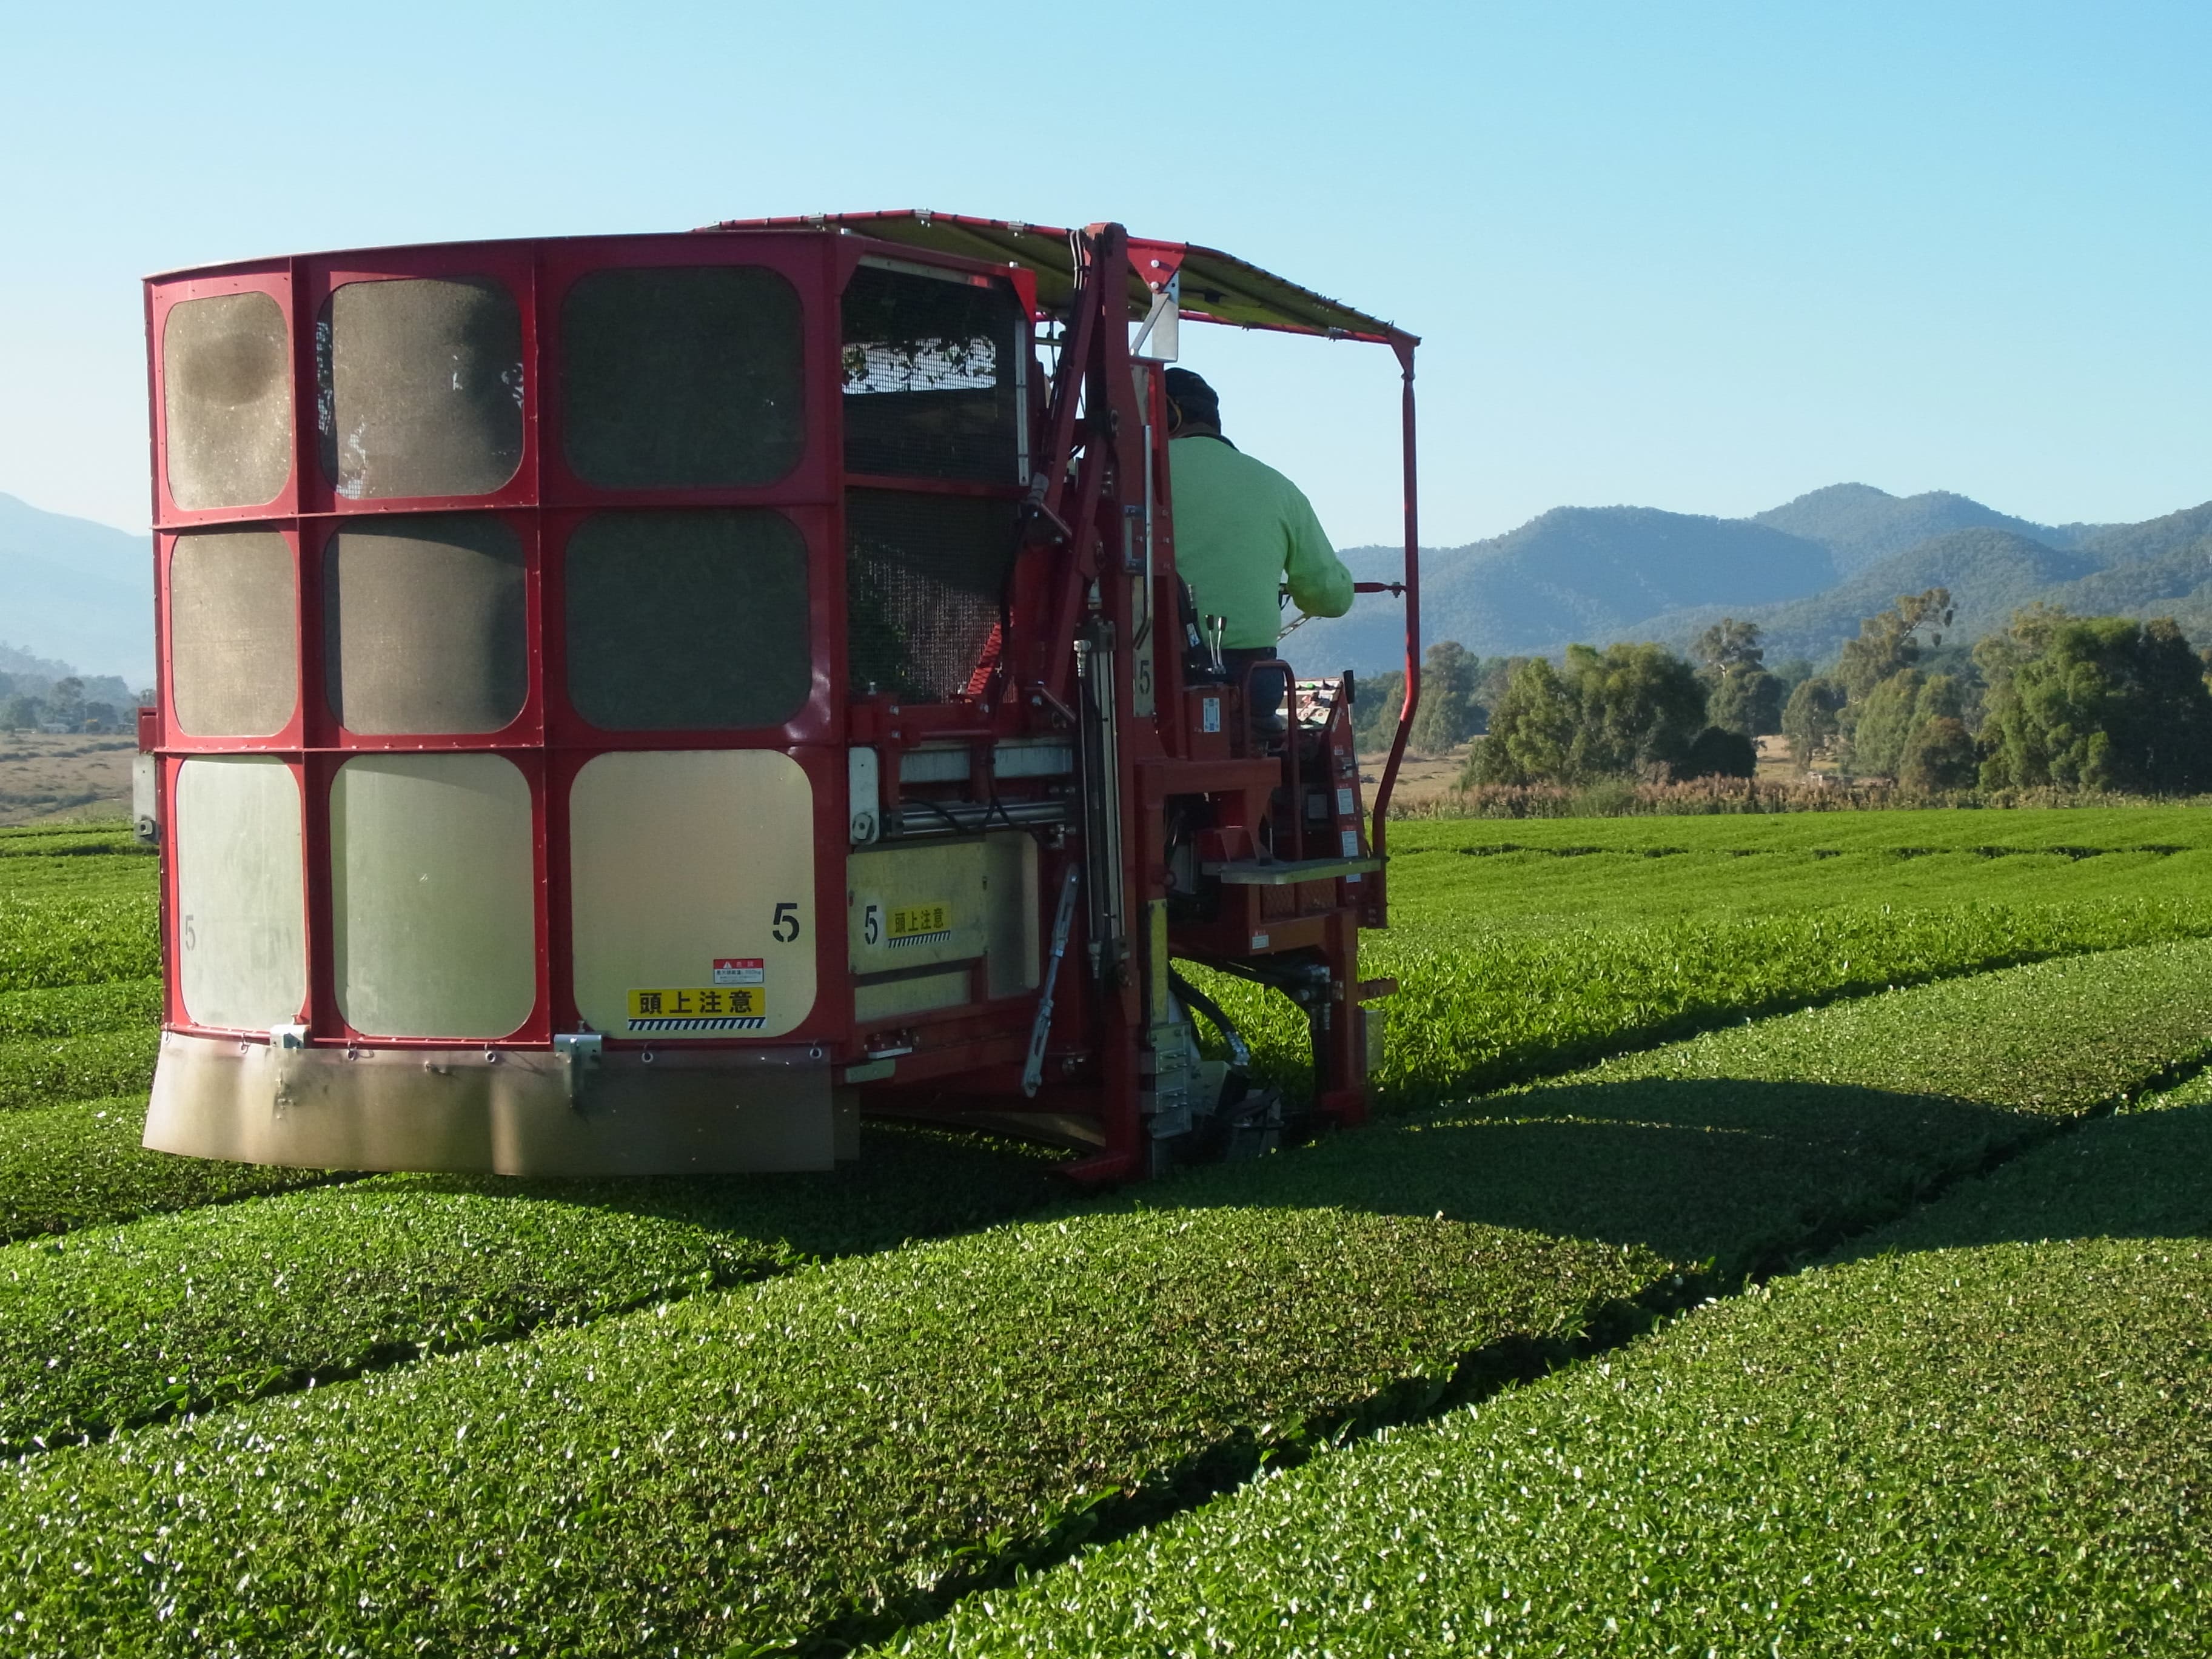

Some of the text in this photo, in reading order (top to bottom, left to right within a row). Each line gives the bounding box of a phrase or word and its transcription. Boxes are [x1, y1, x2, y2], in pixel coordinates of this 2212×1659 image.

[1139, 660, 1150, 694] 5
[186, 914, 195, 951] 5
[773, 903, 800, 942] 5
[865, 905, 878, 944] 5
[894, 908, 943, 933] 頭上注意
[639, 990, 752, 1014] 頭上注意
